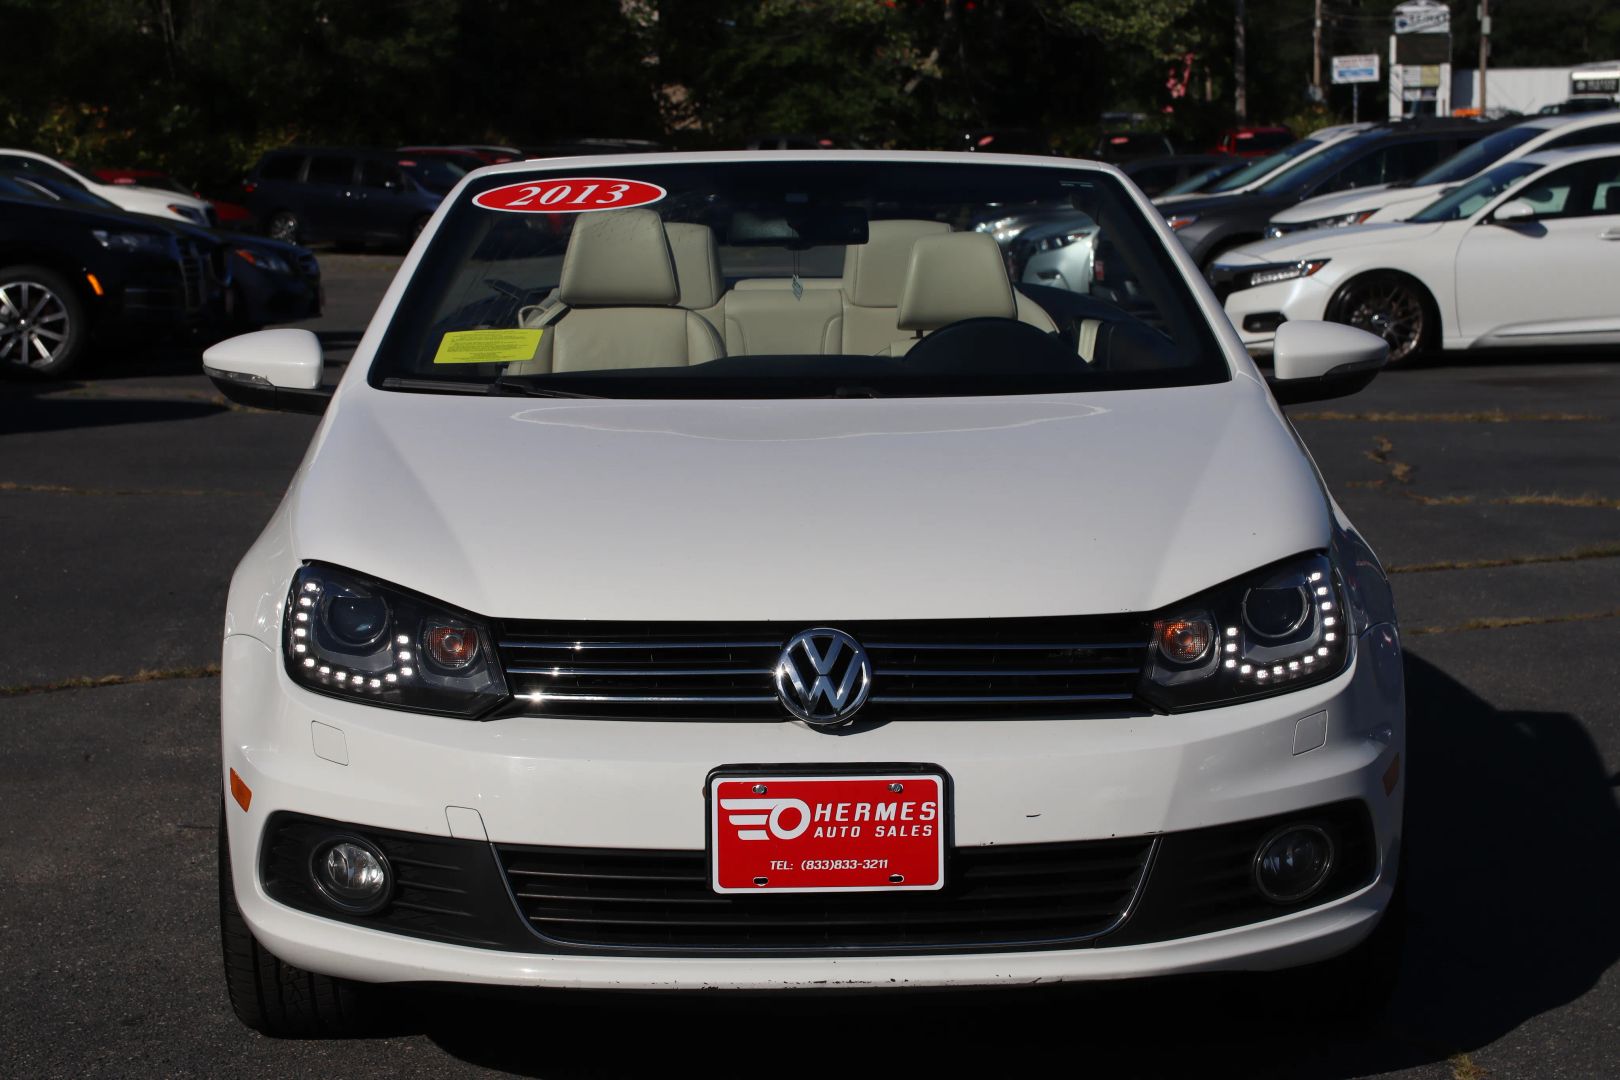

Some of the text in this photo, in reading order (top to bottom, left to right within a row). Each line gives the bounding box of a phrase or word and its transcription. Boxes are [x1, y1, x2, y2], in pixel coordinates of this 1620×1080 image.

[505, 184, 630, 206] 2013
[779, 630, 869, 721] VW
[813, 801, 937, 822] HERMES
[813, 824, 933, 839] AUTO SALES
[770, 859, 889, 871] TEL: (833)833-3211
